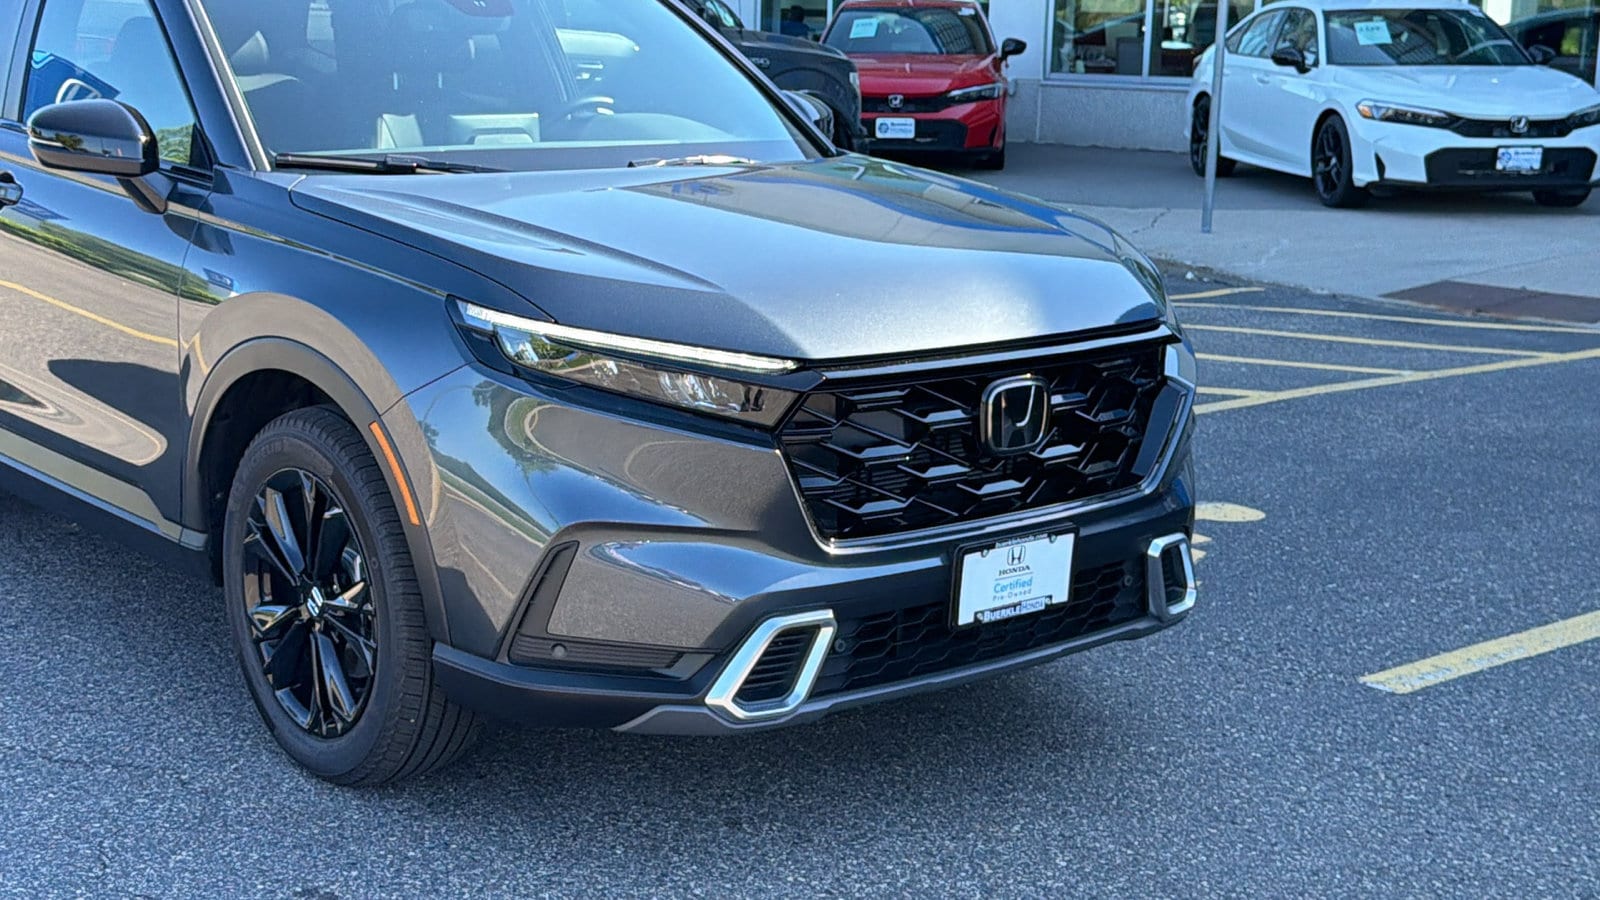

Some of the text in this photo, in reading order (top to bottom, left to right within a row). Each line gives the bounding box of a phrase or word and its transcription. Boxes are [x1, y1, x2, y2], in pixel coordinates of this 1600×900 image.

[998, 564, 1031, 576] HONDA
[994, 576, 1033, 594] Certified
[992, 588, 1032, 602] Pre-Owned
